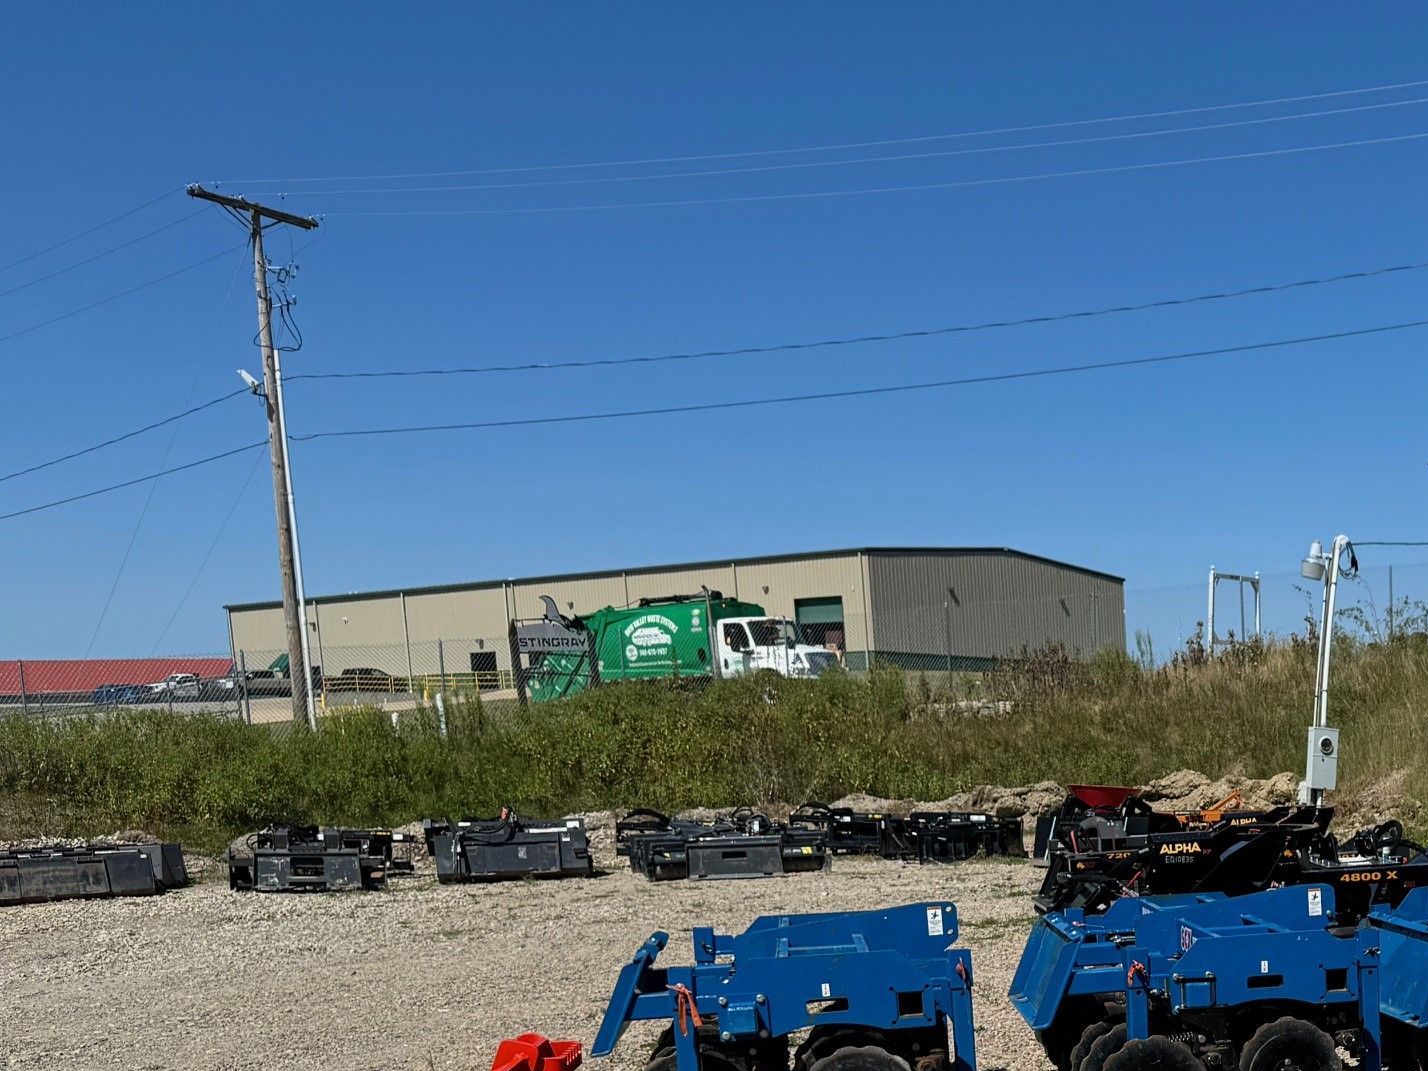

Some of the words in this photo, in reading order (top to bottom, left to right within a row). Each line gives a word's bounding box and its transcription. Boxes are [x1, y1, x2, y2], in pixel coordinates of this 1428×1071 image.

[519, 637, 587, 648] STINGRAY
[1159, 841, 1202, 855] ALPHA
[1340, 872, 1382, 882] 4800
[1386, 870, 1398, 880] X
